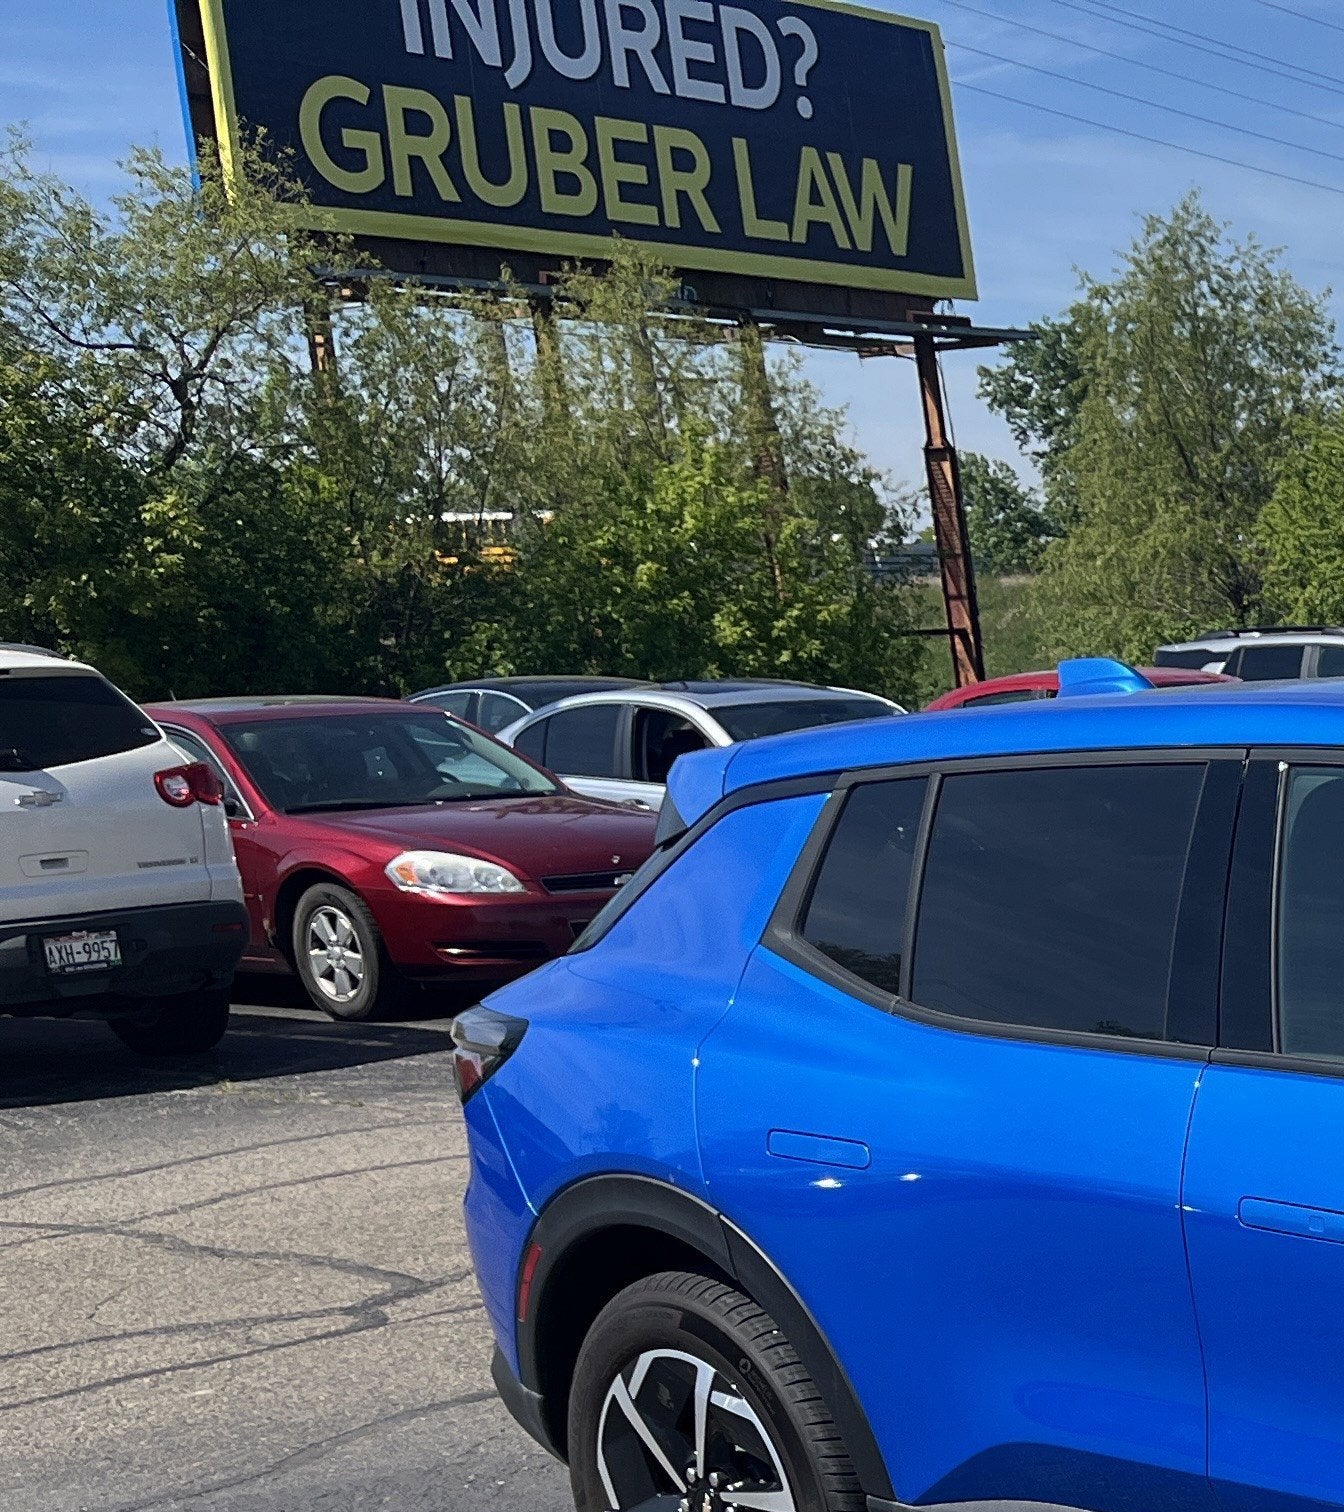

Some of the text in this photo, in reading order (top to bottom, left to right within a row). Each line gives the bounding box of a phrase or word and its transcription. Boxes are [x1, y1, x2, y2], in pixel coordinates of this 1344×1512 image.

[299, 75, 912, 256] GRUBER LAW
[46, 939, 120, 966] AXH-9957
